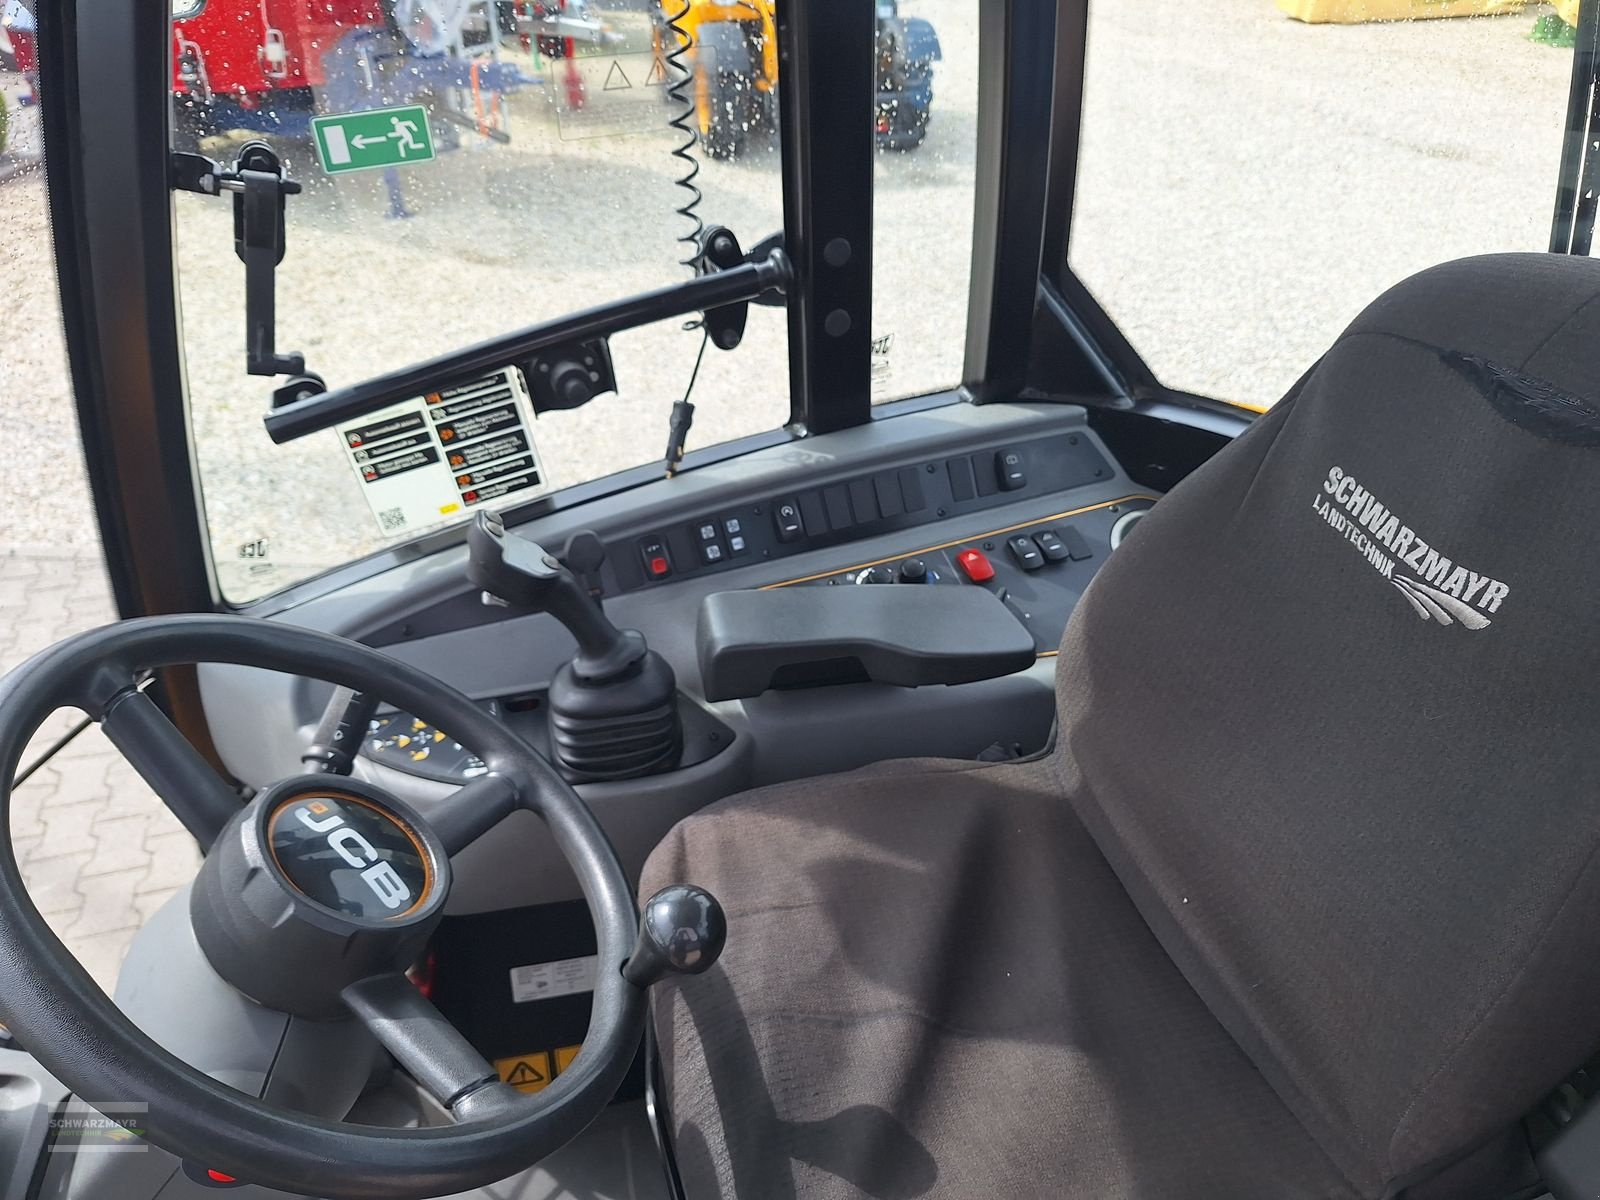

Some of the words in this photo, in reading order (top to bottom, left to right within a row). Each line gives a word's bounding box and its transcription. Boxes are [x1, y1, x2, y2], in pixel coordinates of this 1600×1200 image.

[1312, 493, 1395, 579] LANDTECHNIK
[1323, 465, 1510, 614] SCHWARZMAYR
[294, 806, 411, 909] JCB
